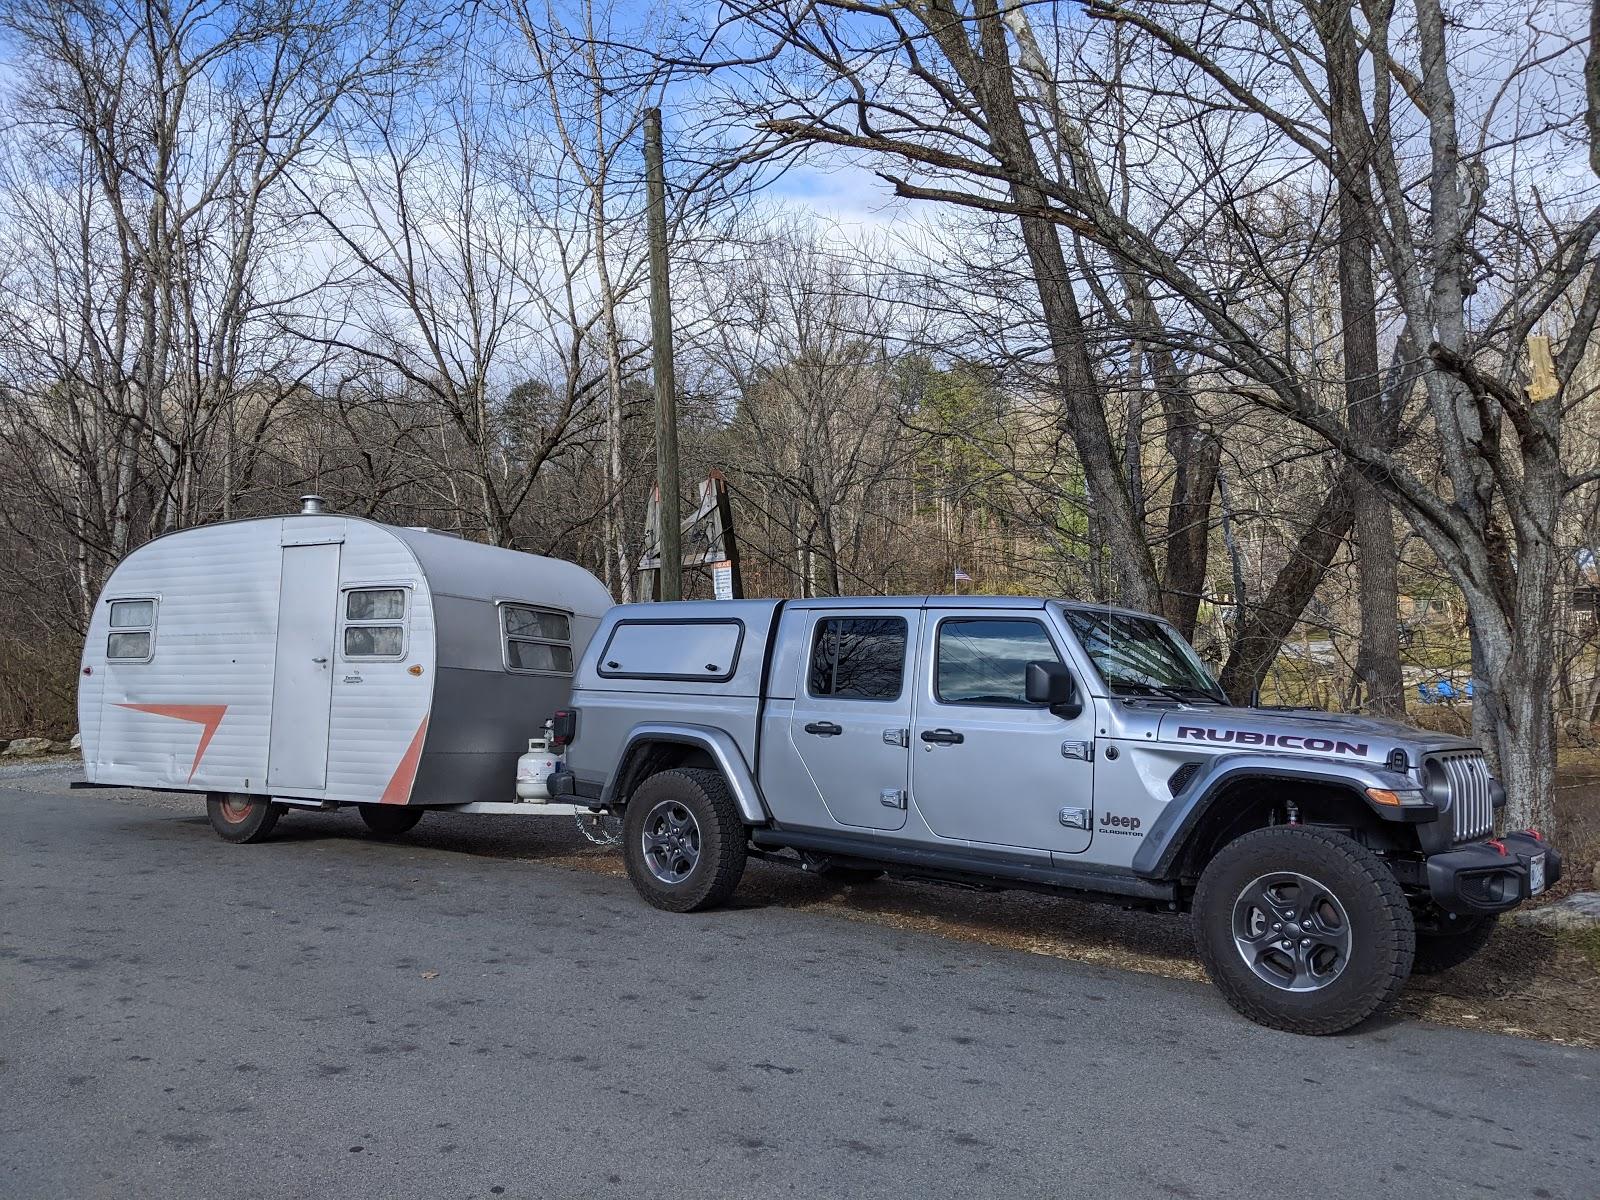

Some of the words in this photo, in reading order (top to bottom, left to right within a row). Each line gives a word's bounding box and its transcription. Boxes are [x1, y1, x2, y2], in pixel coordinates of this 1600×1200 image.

[1177, 726, 1369, 756] RUBICON
[1100, 812, 1141, 831] Jeep
[1099, 828, 1144, 837] GLADIATOR
